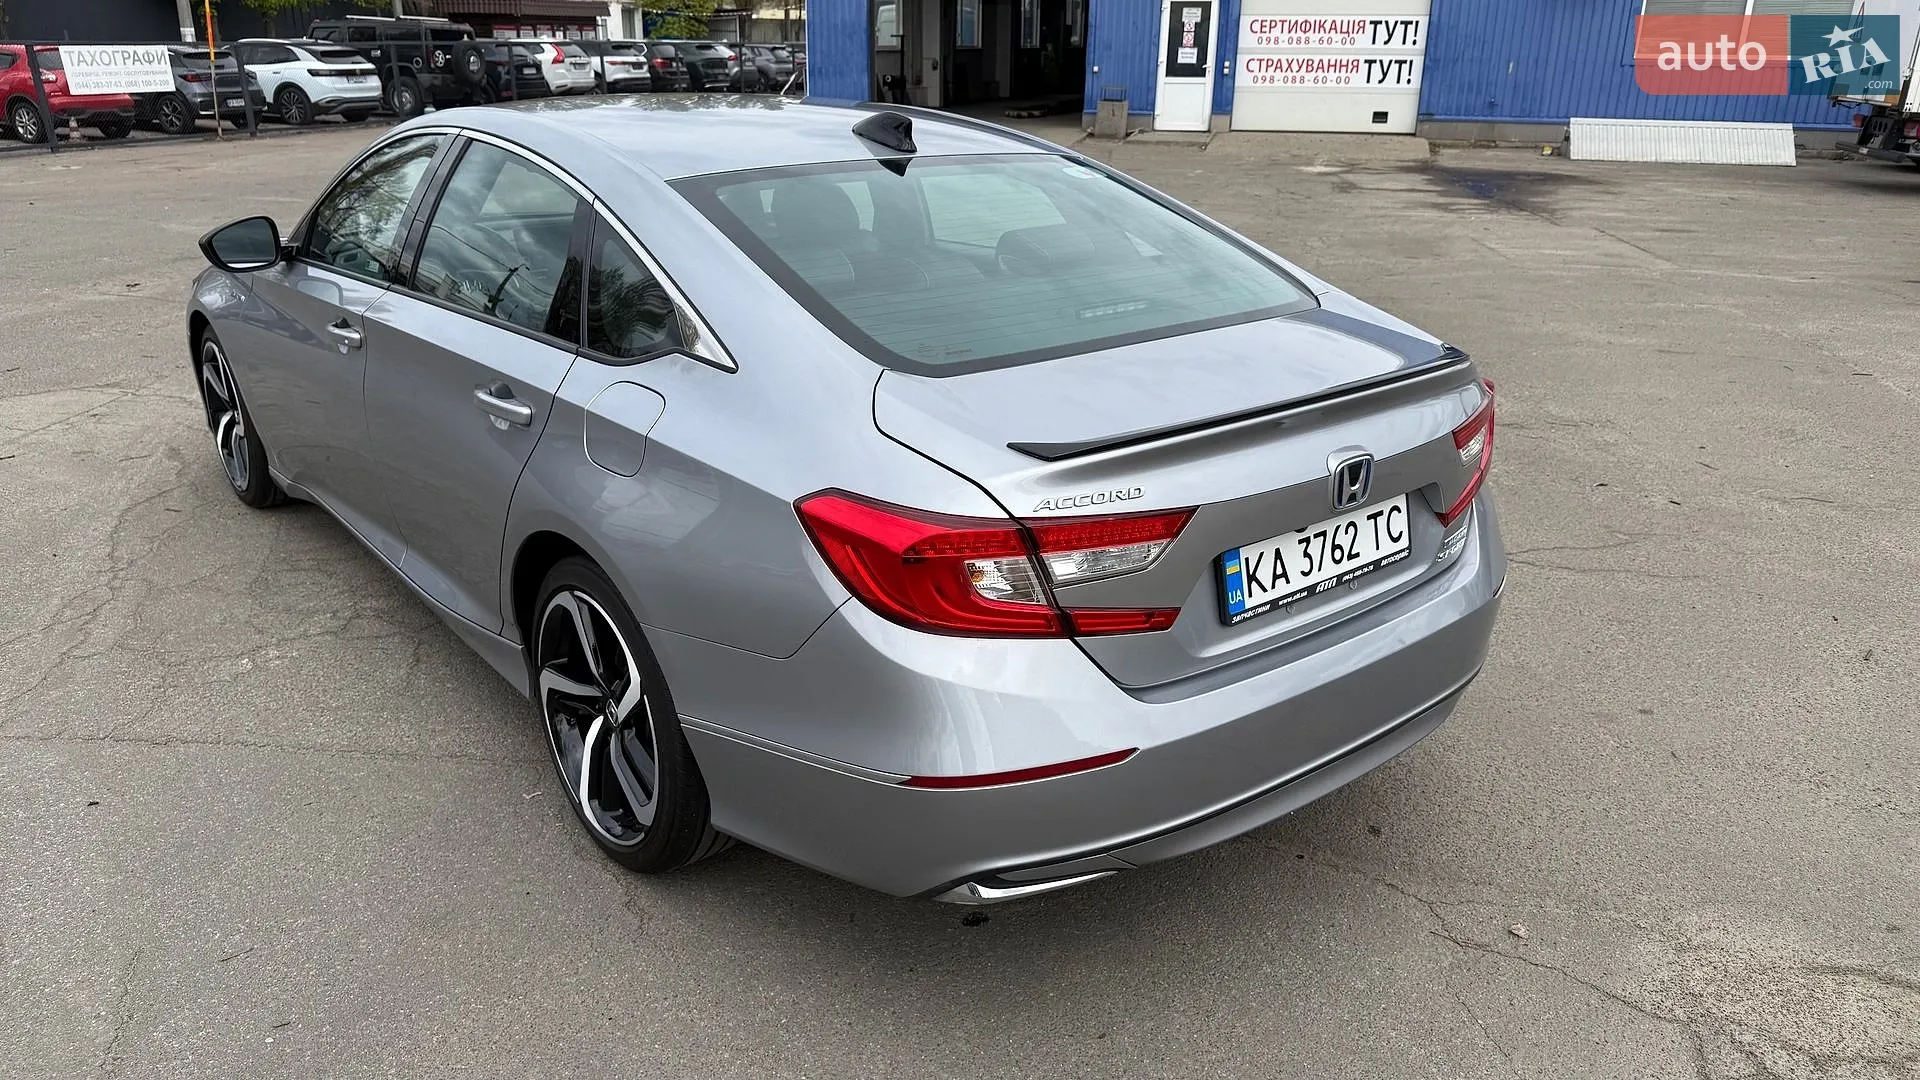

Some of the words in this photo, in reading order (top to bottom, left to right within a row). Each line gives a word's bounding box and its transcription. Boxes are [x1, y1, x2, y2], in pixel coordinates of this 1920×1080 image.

[1249, 19, 1366, 37] СЕРТИФІКАЦІЯ
[1369, 20, 1420, 46] ТУТ!
[1256, 36, 1356, 46] 098-088-60-00
[63, 50, 168, 67] ТАХОГРАФИ
[1246, 58, 1361, 74] СТРАХУВАННЯ
[1363, 59, 1414, 85] ТУТ!
[1252, 75, 1351, 85] 098-088-60-00
[1033, 486, 1146, 512] ACCORD
[1244, 546, 1291, 598] KA
[1297, 520, 1361, 577] 3762
[1366, 504, 1404, 551] TC
[1228, 588, 1244, 605] UA
